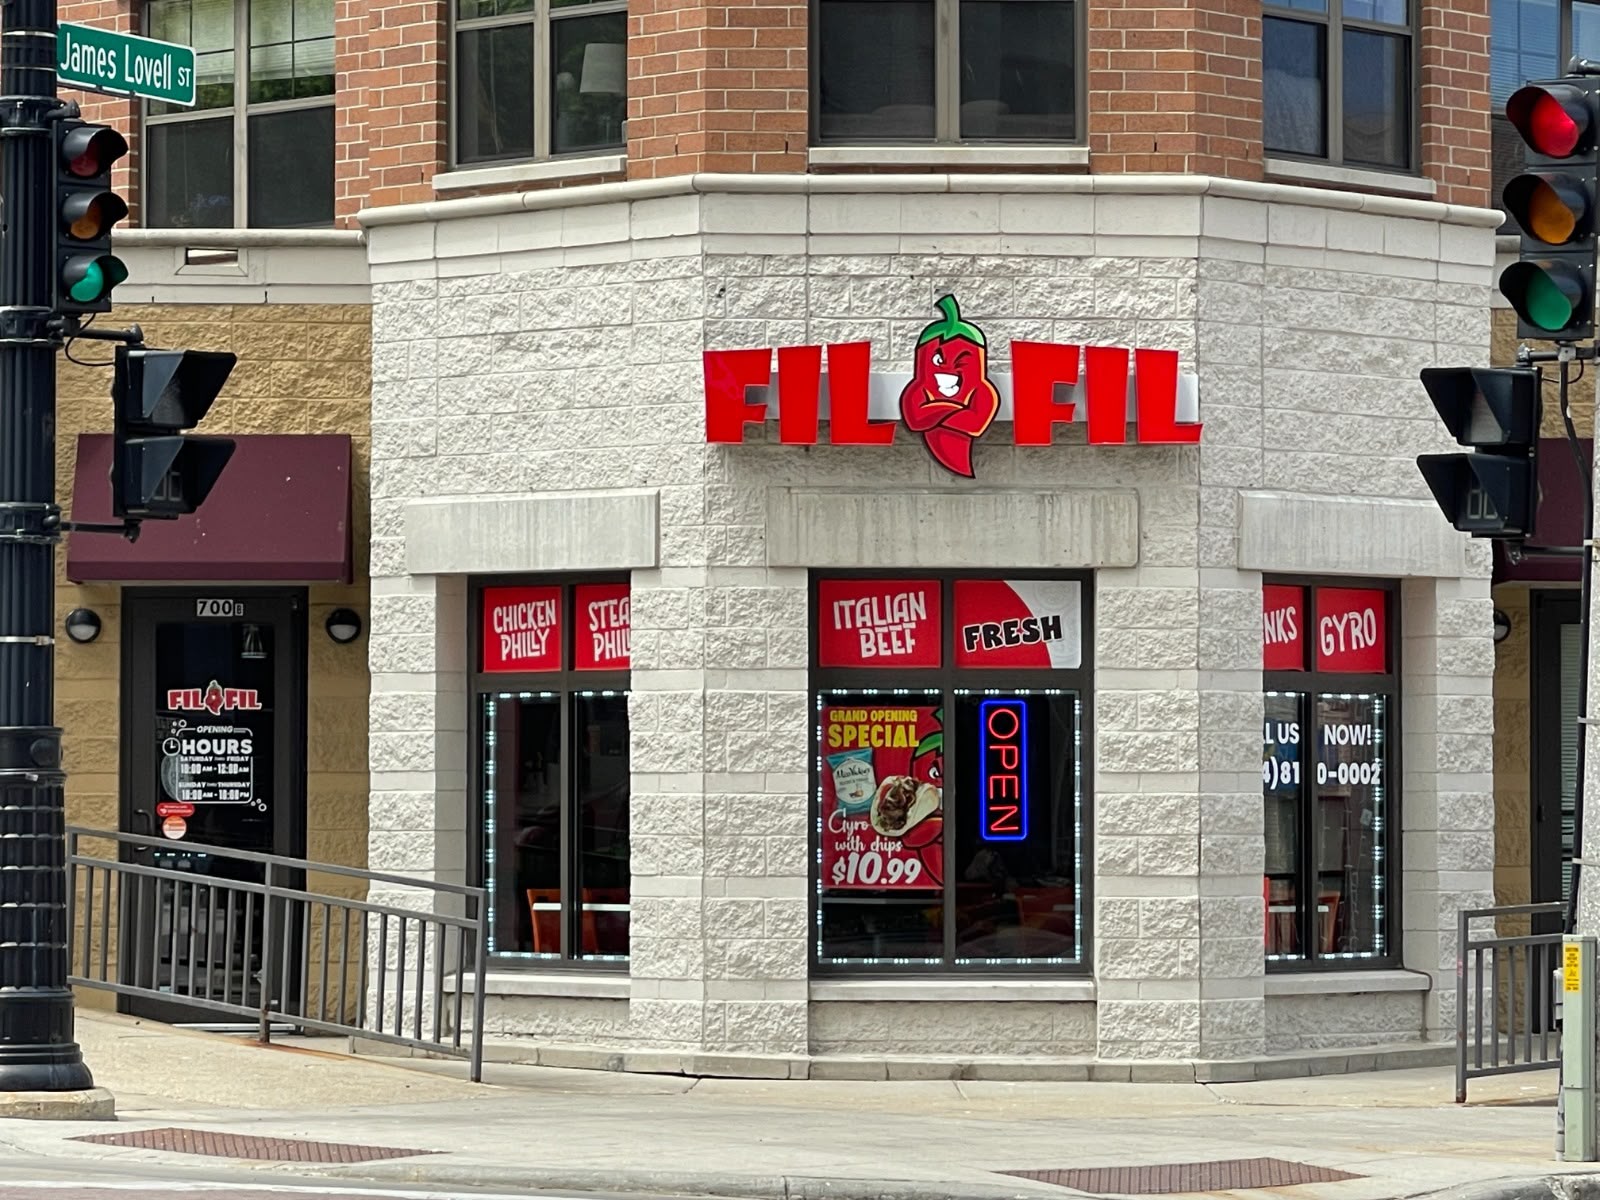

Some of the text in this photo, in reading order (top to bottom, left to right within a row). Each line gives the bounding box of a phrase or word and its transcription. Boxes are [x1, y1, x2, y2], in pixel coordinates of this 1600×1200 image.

[60, 32, 191, 90] James Lovell ST
[703, 340, 1203, 446] FIL FIL
[198, 600, 232, 615] 700
[493, 599, 556, 634] CHICKEN
[588, 596, 630, 632] STEA
[833, 591, 927, 630] ITALIAN
[859, 622, 916, 658] BEEF
[963, 615, 1063, 653] FRESH
[1263, 606, 1298, 645] NKS
[1320, 608, 1377, 656] GYRO
[500, 628, 550, 661] PHILLY
[592, 628, 630, 662] PHIL
[168, 688, 262, 710] FIL FIL
[830, 710, 918, 722] GRAND OPENING
[196, 725, 234, 734] OPENING
[828, 724, 919, 748] SPECIAL
[1277, 722, 1300, 744] US
[1324, 724, 1372, 746] NOW!
[182, 739, 253, 755] HOURS
[988, 708, 1019, 831] OPEN
[828, 808, 870, 840] Gyro
[835, 835, 903, 858] with chips
[832, 851, 922, 885] $10.99
